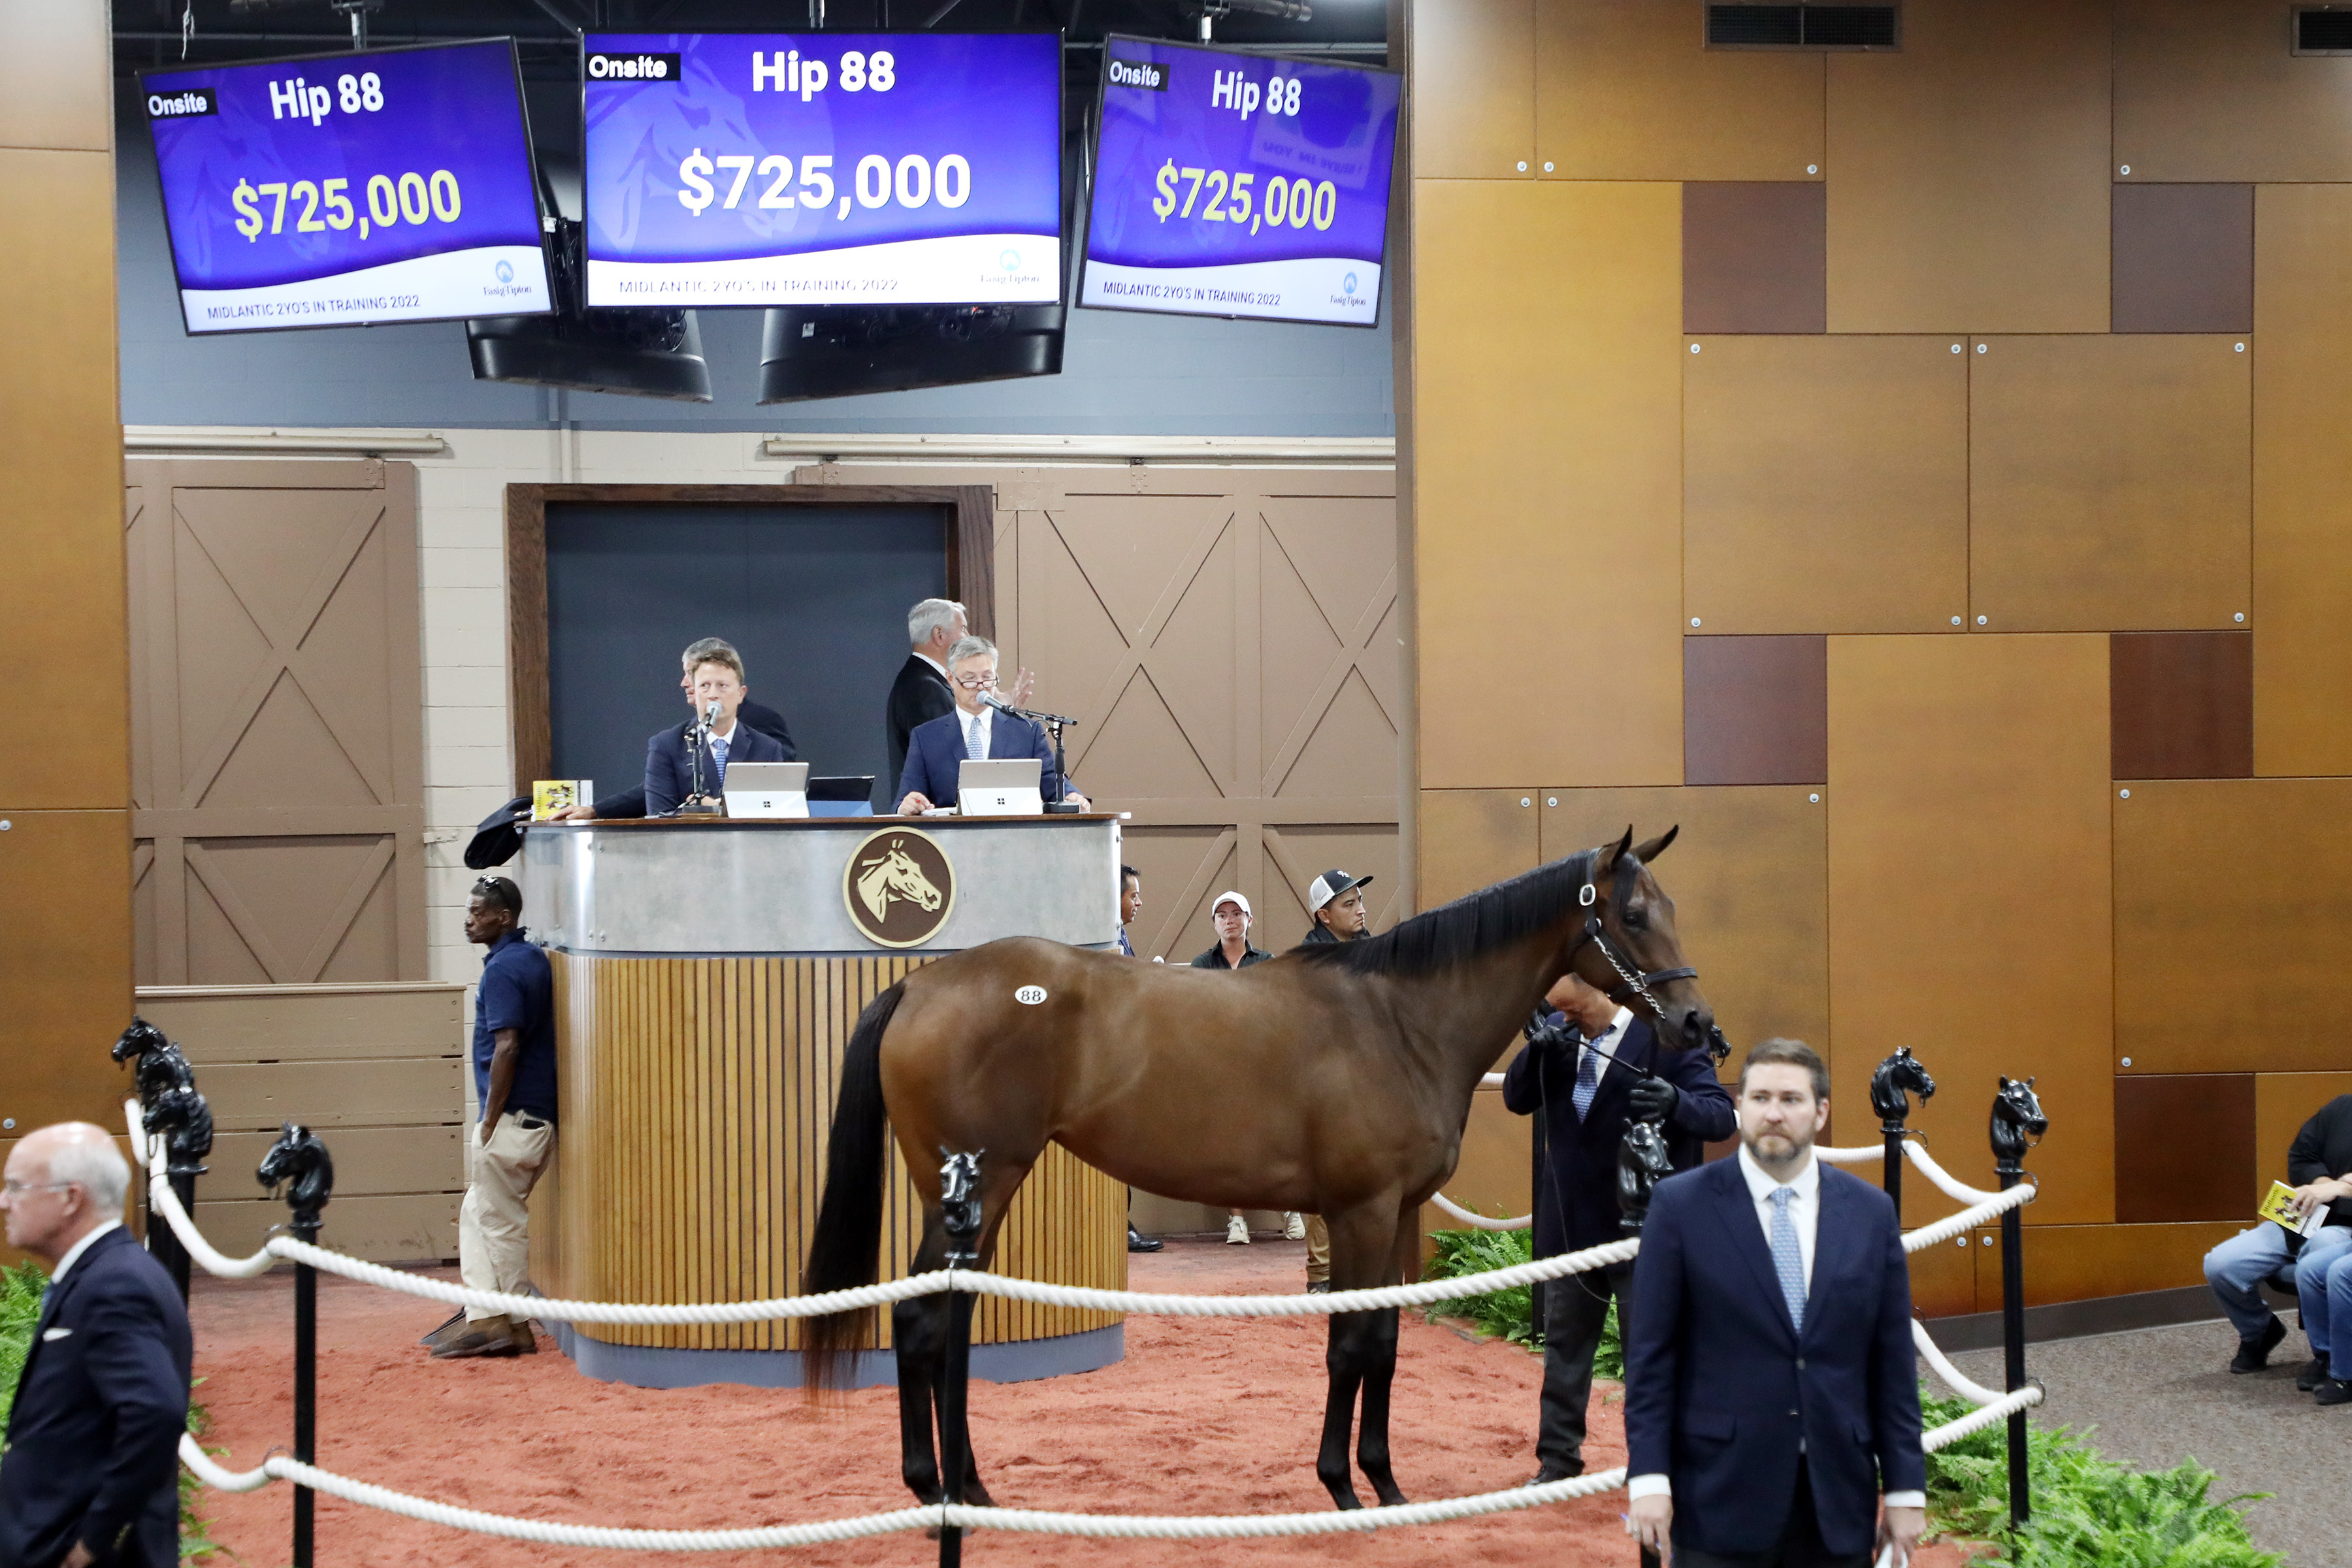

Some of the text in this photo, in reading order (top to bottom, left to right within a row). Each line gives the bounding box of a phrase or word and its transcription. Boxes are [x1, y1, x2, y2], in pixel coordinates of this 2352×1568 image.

[589, 56, 667, 78] Onsite
[753, 50, 896, 103] Hip 88
[1109, 61, 1160, 87] Onsite
[148, 93, 207, 116] Onsite
[269, 72, 384, 126] Hip 88
[1211, 69, 1301, 120] Hip 88
[678, 148, 972, 221] $725,000
[1152, 157, 1336, 237] $725,000
[232, 169, 461, 244] $725,000
[620, 281, 707, 293] MIDLANTIC
[761, 280, 776, 291] IN
[784, 280, 856, 291] TRAINING
[862, 279, 898, 291] 2022
[1103, 281, 1281, 306] MIDLANTIC 2YO'S IN TRAINING 2022
[207, 294, 420, 319] MIDLANTIC 2YO'S IN TRAINING 2022
[1021, 990, 1041, 1002] 88
